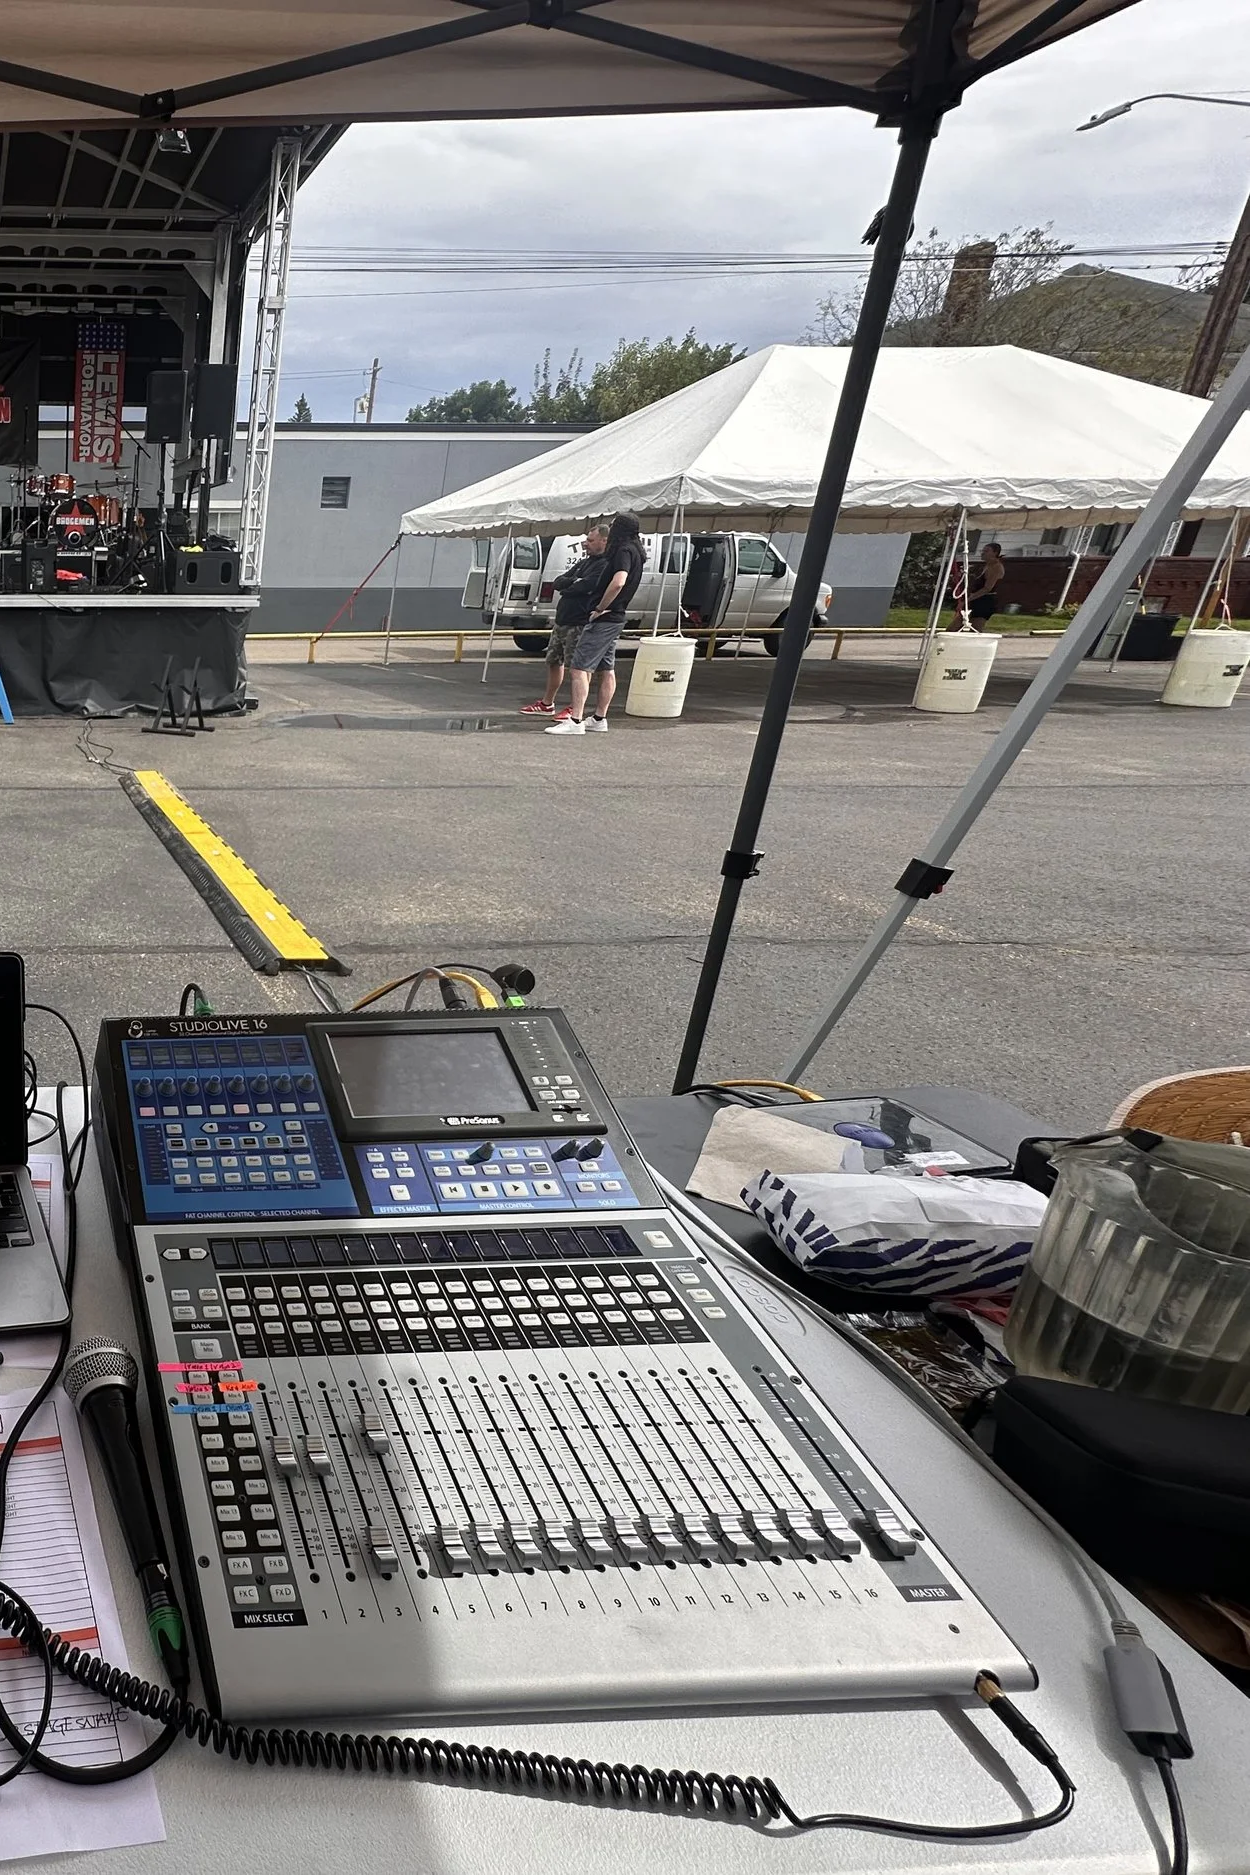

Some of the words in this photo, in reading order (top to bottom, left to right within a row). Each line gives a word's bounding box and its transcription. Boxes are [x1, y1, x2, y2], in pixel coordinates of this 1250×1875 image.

[81, 354, 95, 392] FOR
[93, 354, 119, 458] LEWIS
[79, 397, 93, 457] MAYOR
[56, 517, 95, 525] BADGEMEN
[169, 1020, 250, 1033] STUDIOLIVE
[252, 1019, 268, 1030] 16
[460, 1117, 500, 1125] PreSonus
[736, 1280, 789, 1324] COSCO
[232, 1561, 241, 1569] FX
[792, 1591, 806, 1601] 14
[828, 1590, 842, 1599] 15
[864, 1588, 878, 1598] 16
[909, 1587, 949, 1598] MASTER
[648, 1597, 661, 1607] 10
[685, 1596, 697, 1605] 11
[721, 1594, 734, 1604] 12
[756, 1593, 770, 1602] 13
[505, 1603, 513, 1612] 6
[541, 1602, 548, 1611] 7
[578, 1600, 586, 1609] 8
[614, 1599, 622, 1608] 9
[358, 1608, 365, 1618] 2
[395, 1607, 402, 1616] 3
[432, 1606, 439, 1615] 4
[469, 1604, 476, 1614] 5
[244, 1614, 263, 1623] MIX
[264, 1612, 294, 1623] SELECT
[322, 1610, 328, 1619] 1
